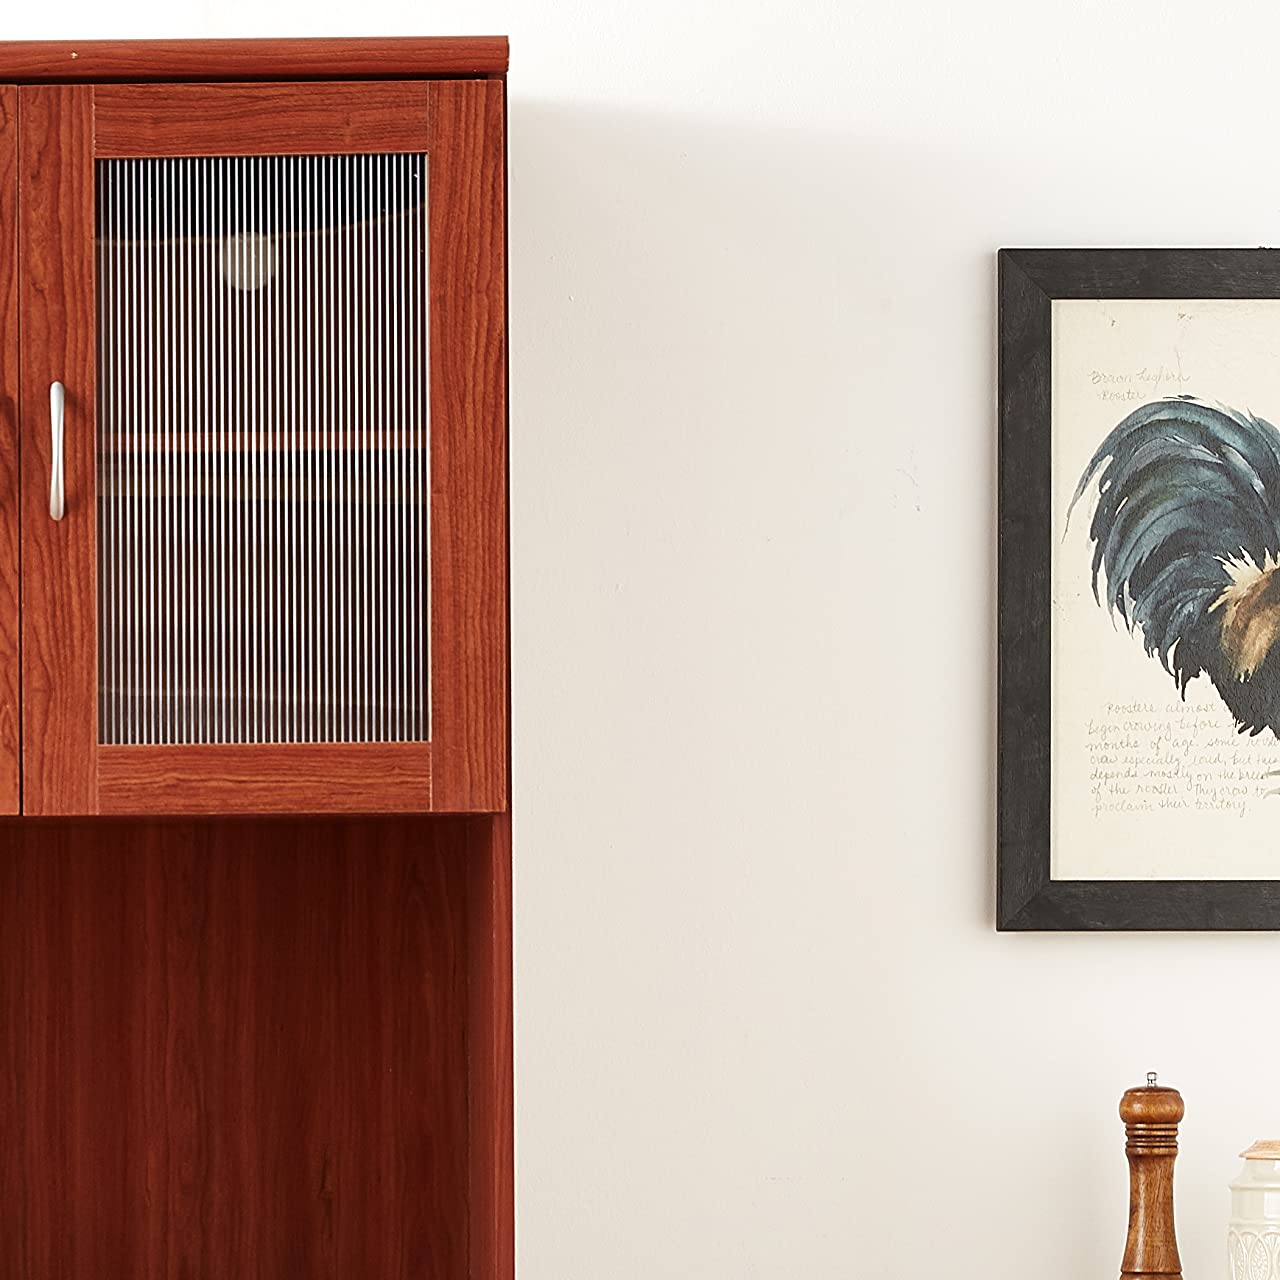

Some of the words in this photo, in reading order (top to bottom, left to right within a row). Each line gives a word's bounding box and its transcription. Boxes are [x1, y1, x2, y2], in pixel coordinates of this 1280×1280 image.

[1150, 736, 1162, 755] of
[1091, 782, 1102, 803] of
[1109, 784, 1129, 796] the
